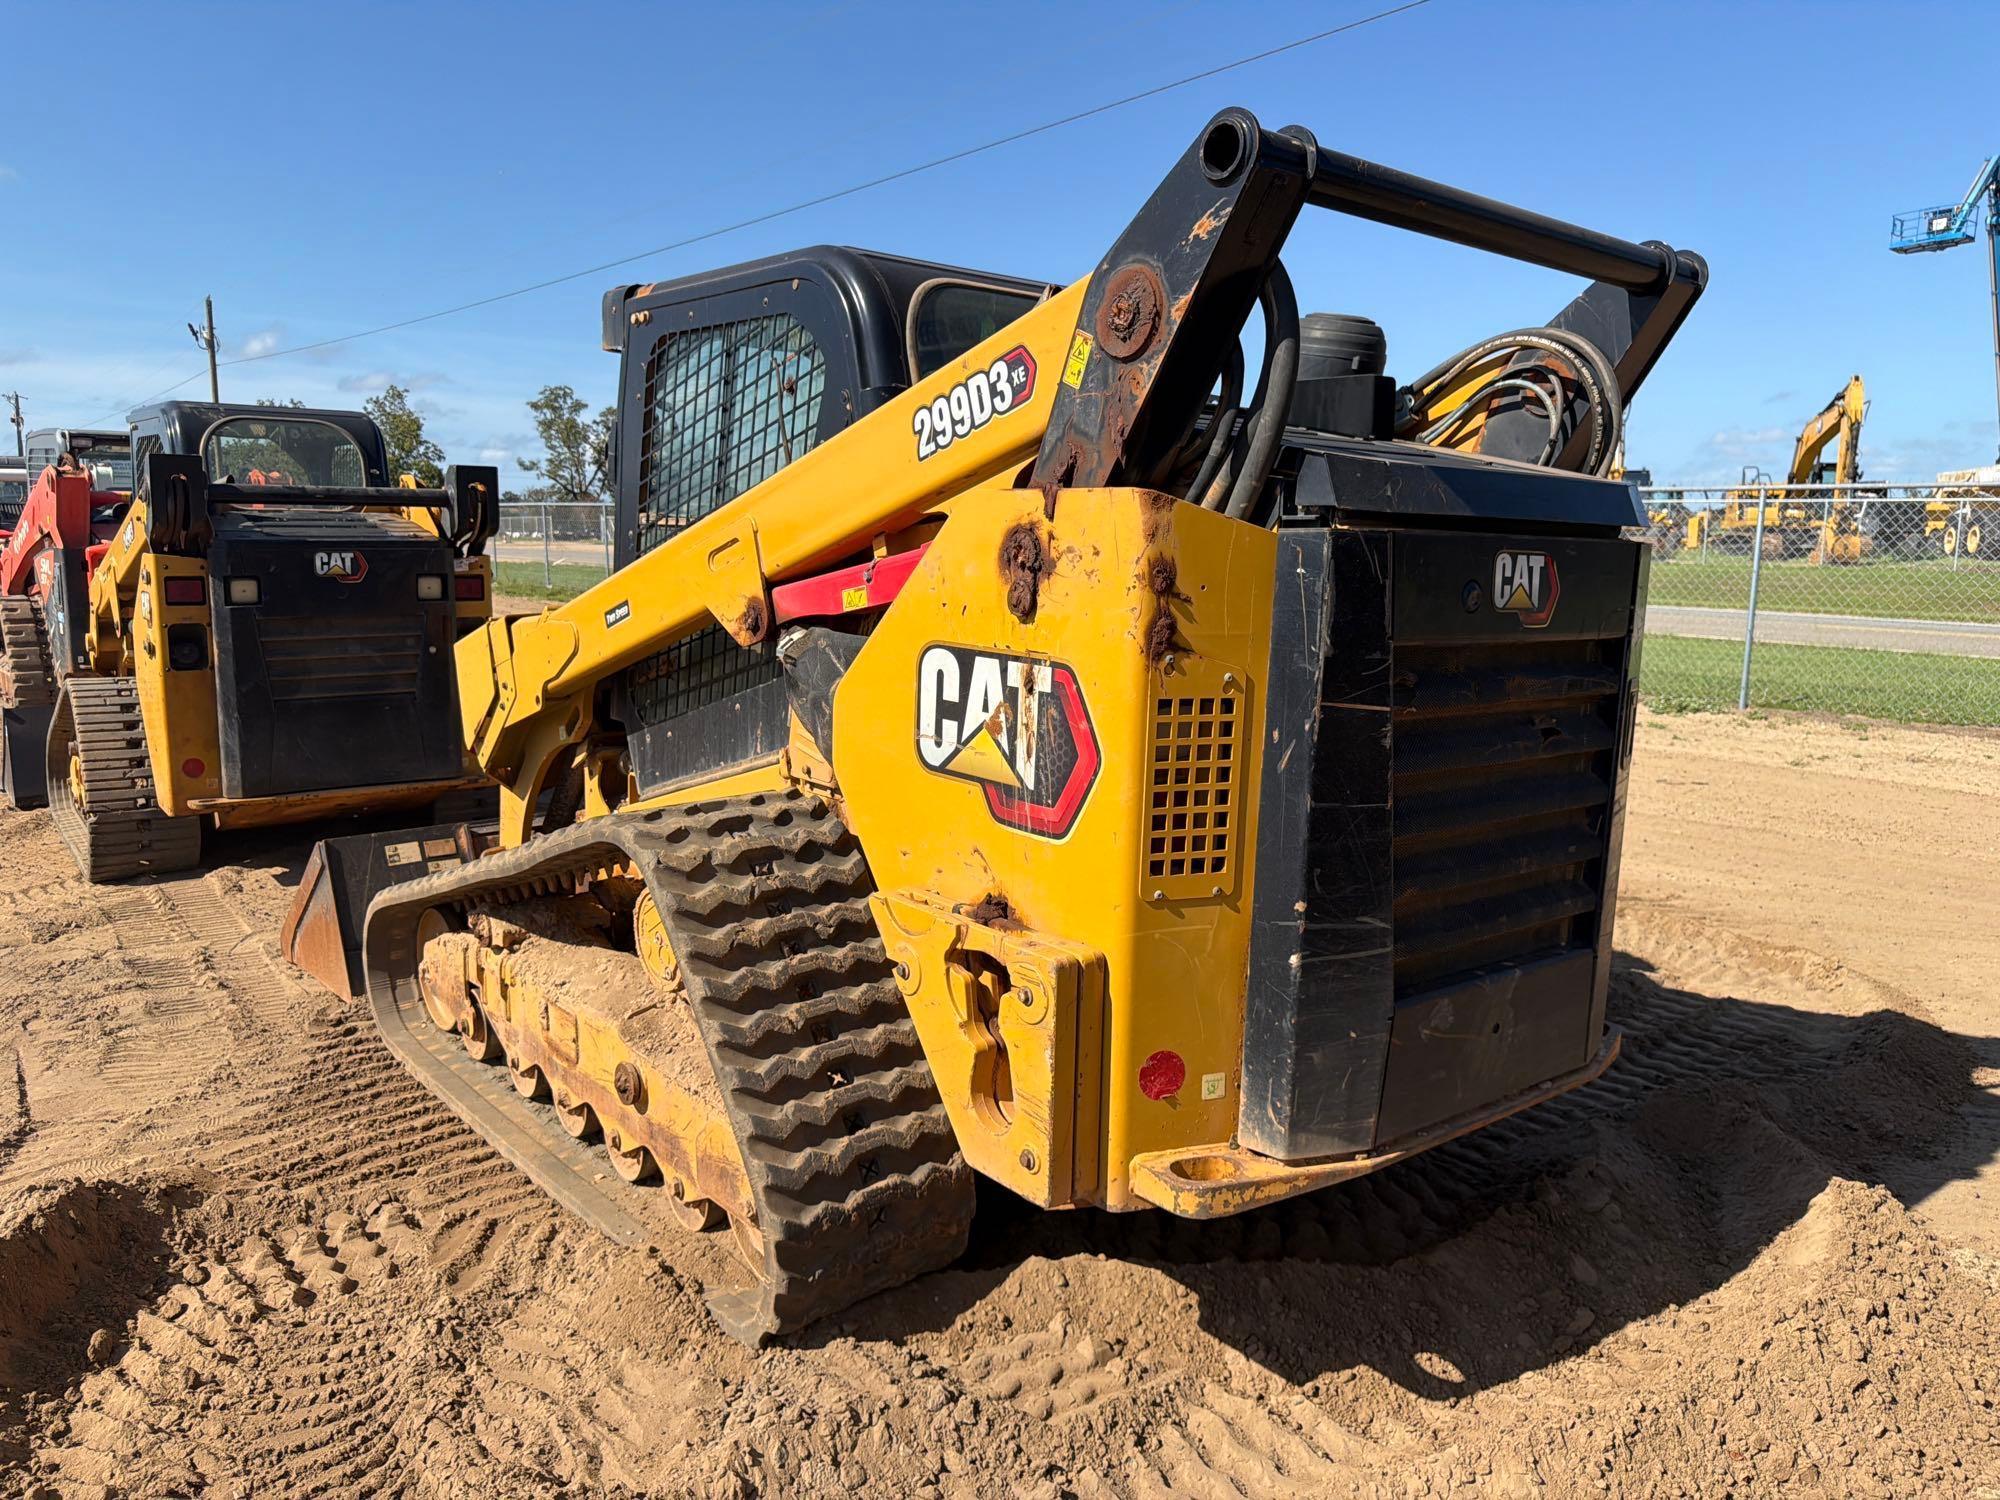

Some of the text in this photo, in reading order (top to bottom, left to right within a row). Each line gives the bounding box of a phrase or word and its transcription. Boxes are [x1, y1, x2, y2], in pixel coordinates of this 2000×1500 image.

[914, 360, 1026, 459] 299D3 XE
[315, 552, 354, 575] CAT
[1495, 553, 1545, 608] CAT
[920, 647, 1053, 790] CAT
